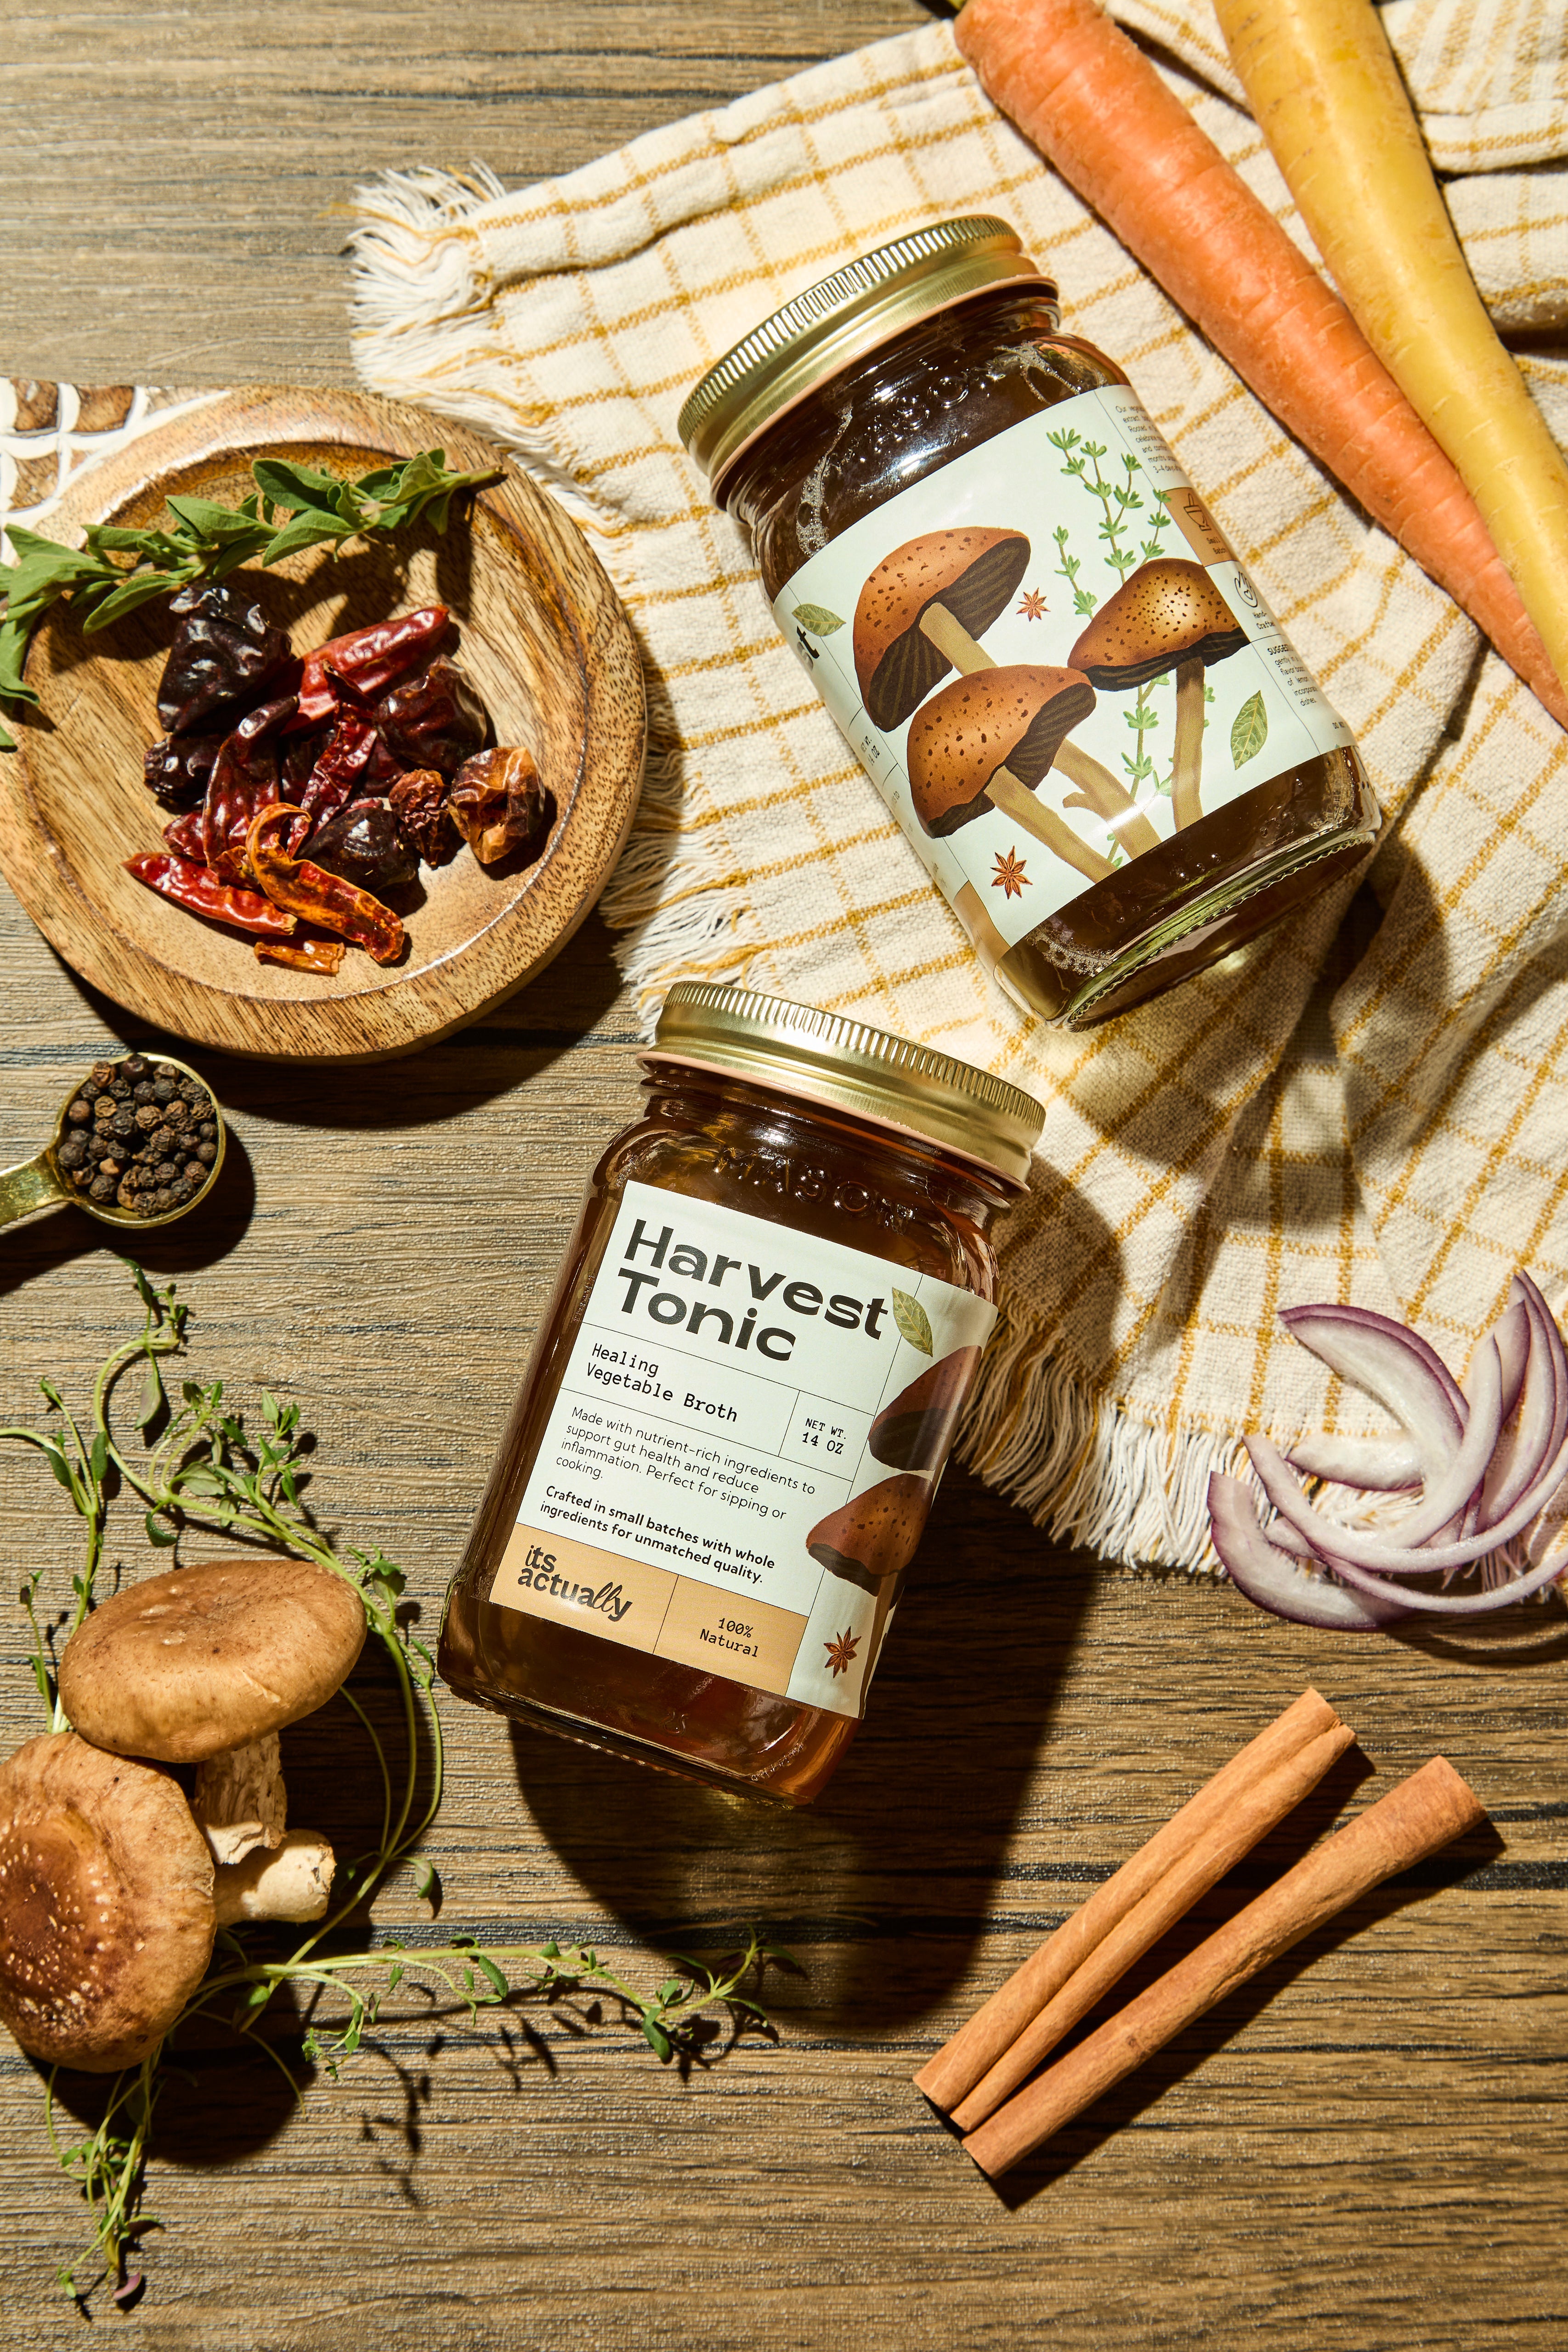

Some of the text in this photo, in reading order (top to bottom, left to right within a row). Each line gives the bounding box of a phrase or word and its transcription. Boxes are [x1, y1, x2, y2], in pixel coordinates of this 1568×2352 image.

[1252, 610, 1267, 619] Hand-
[1280, 667, 1296, 676] flavor
[1287, 678, 1294, 686] of
[624, 1219, 889, 1340] Harvest
[618, 1267, 796, 1361] Tonic
[592, 1343, 658, 1377] Healing
[588, 1363, 736, 1422] Vegetable Broth
[802, 1432, 843, 1454] 14 OZ
[805, 1418, 846, 1439] NET WT.
[566, 1426, 759, 1493] support gut health and reduce
[572, 1407, 602, 1425] Made
[607, 1420, 632, 1435] with
[725, 1455, 798, 1488] ingredients
[803, 1482, 815, 1494] to
[557, 1458, 602, 1480] cooking.
[561, 1442, 786, 1519] inflammation. Perfect for sipping or
[540, 1501, 762, 1583] ingredients for unmatched quality.
[547, 1486, 774, 1568] Crafted in small batches with whole
[525, 1545, 557, 1573] its
[518, 1567, 633, 1622] actually
[700, 1629, 758, 1657] Natural
[719, 1618, 753, 1638] 100%
